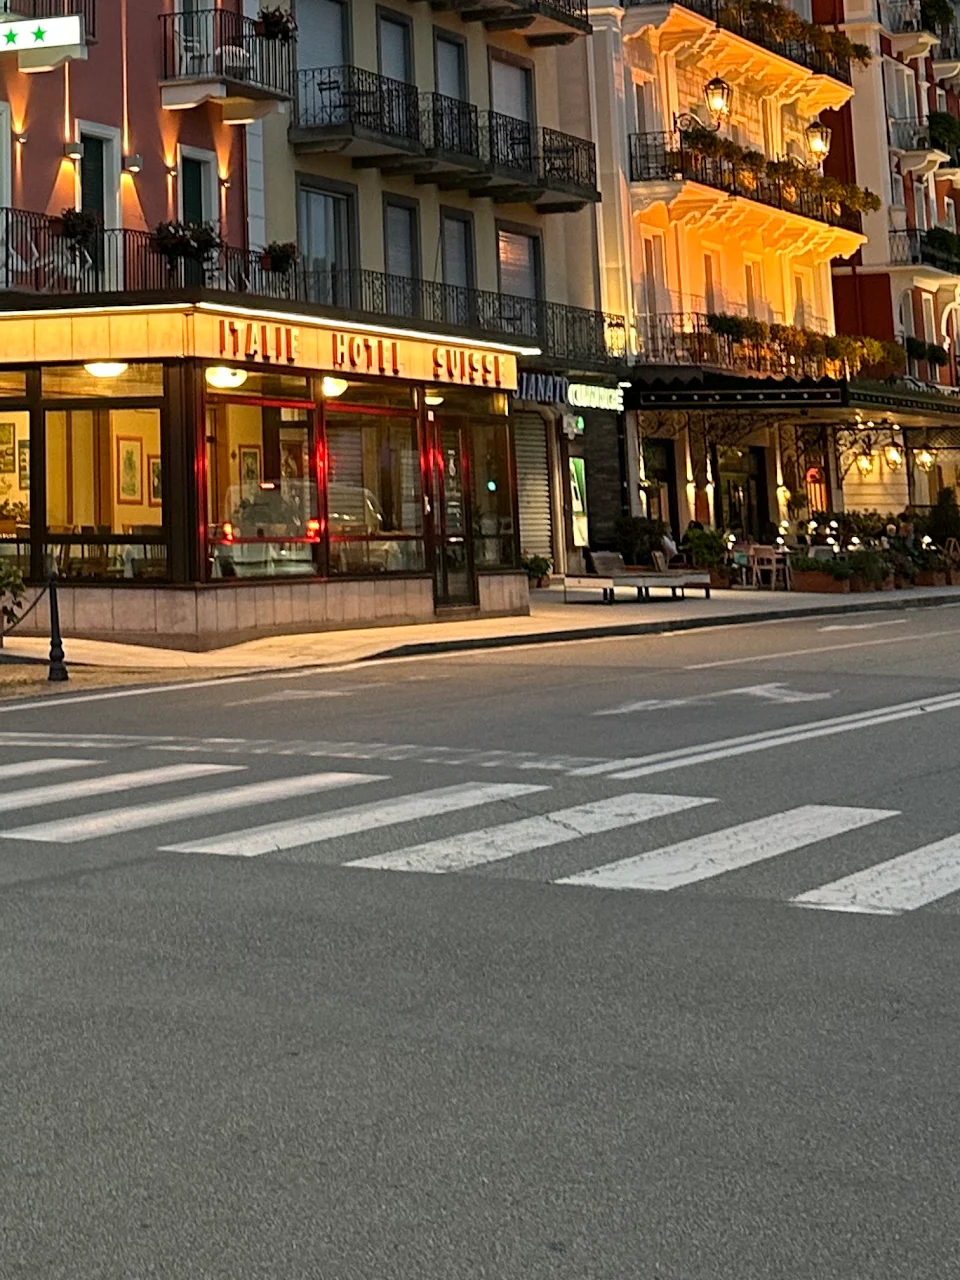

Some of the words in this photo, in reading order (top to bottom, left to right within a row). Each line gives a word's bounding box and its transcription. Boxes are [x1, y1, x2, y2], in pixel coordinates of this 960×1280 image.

[218, 319, 301, 363] ITALIE
[332, 333, 406, 375] HOTEL
[432, 347, 506, 387] SUISSE
